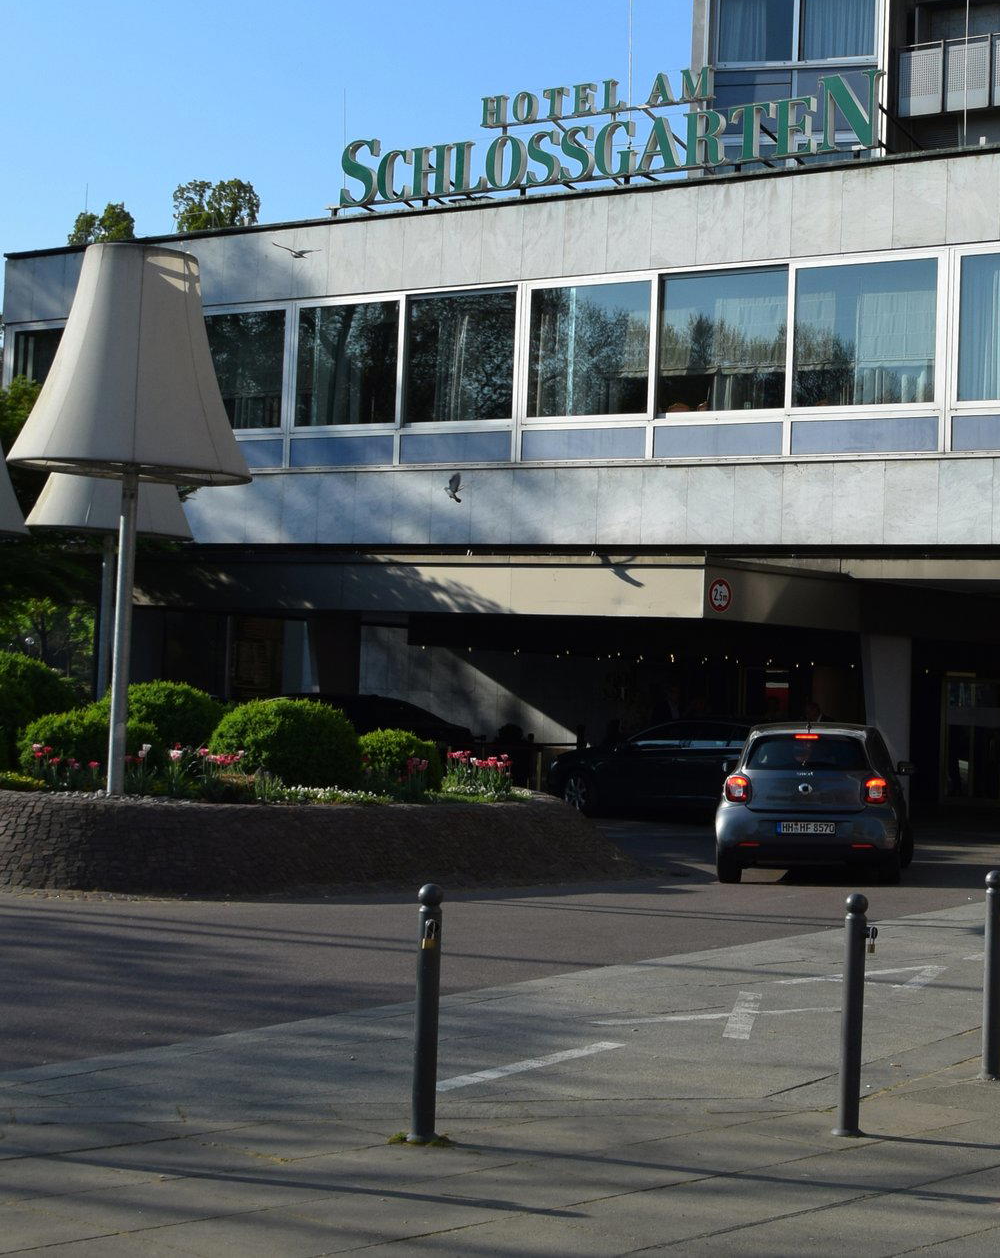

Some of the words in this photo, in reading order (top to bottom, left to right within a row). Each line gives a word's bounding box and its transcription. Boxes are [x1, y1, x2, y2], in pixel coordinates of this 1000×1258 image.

[480, 78, 626, 127] HOTEL
[645, 65, 716, 105] AM
[339, 68, 887, 208] SCHLOSSGARTEN
[782, 823, 794, 833] HH
[813, 823, 835, 833] 8570
